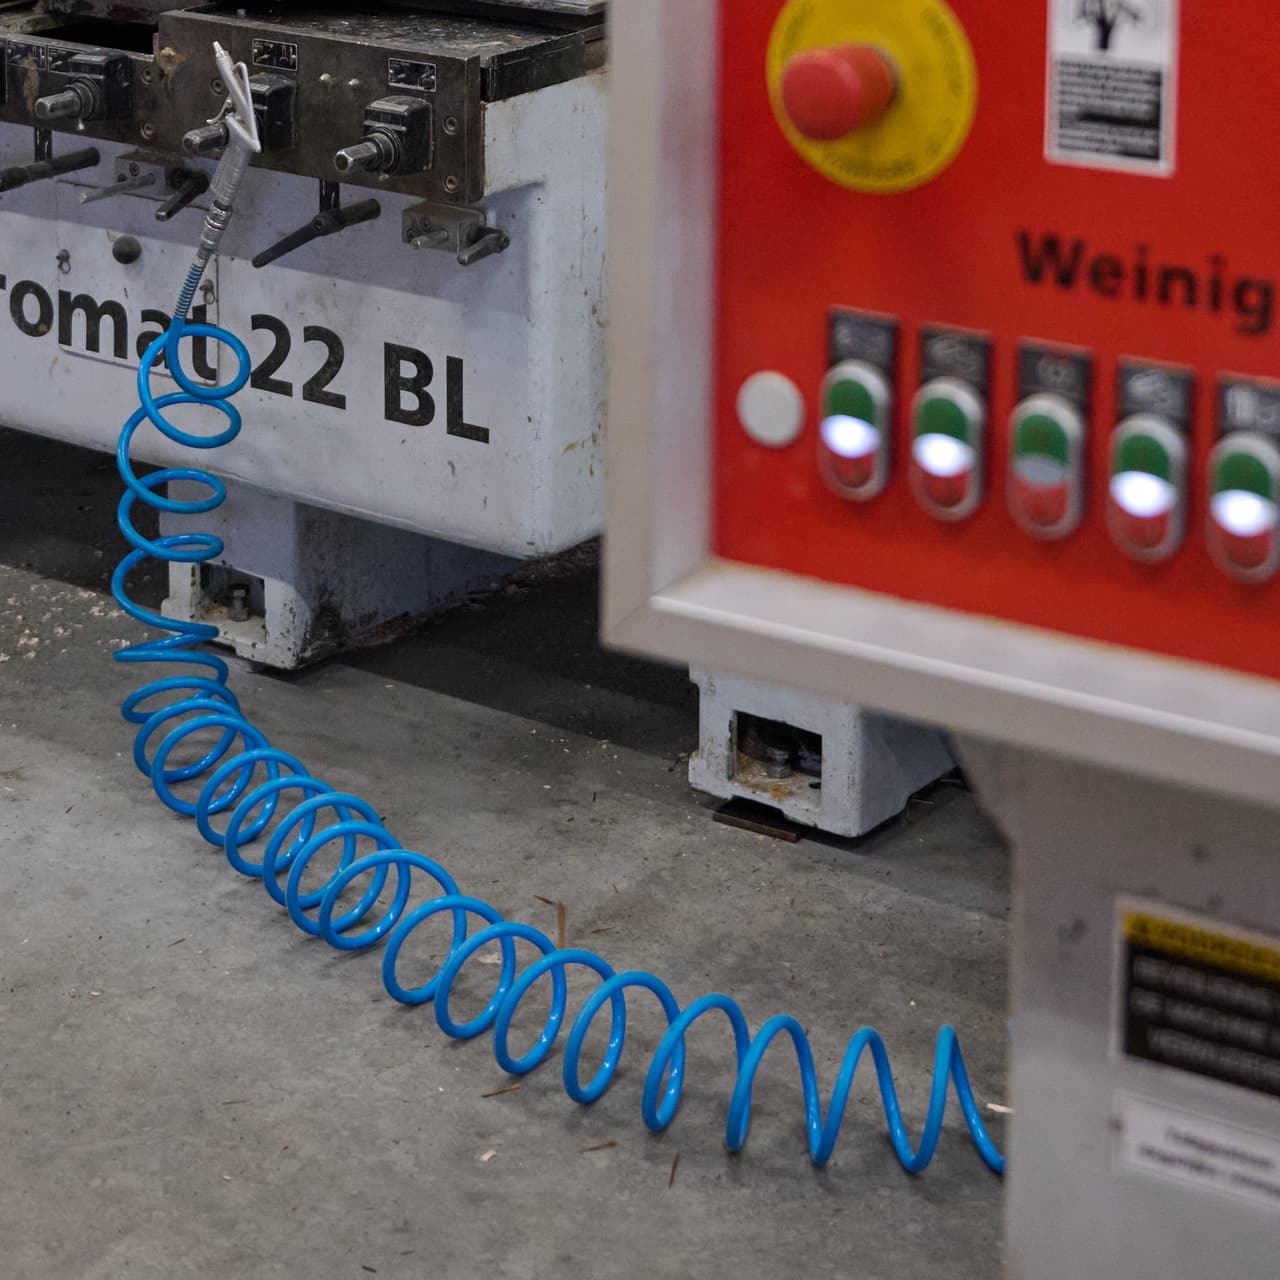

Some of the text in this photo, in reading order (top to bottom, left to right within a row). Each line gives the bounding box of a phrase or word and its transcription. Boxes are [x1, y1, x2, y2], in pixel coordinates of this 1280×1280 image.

[1016, 230, 1276, 337] Weinig
[250, 312, 346, 410] 22
[383, 341, 490, 445] BL
